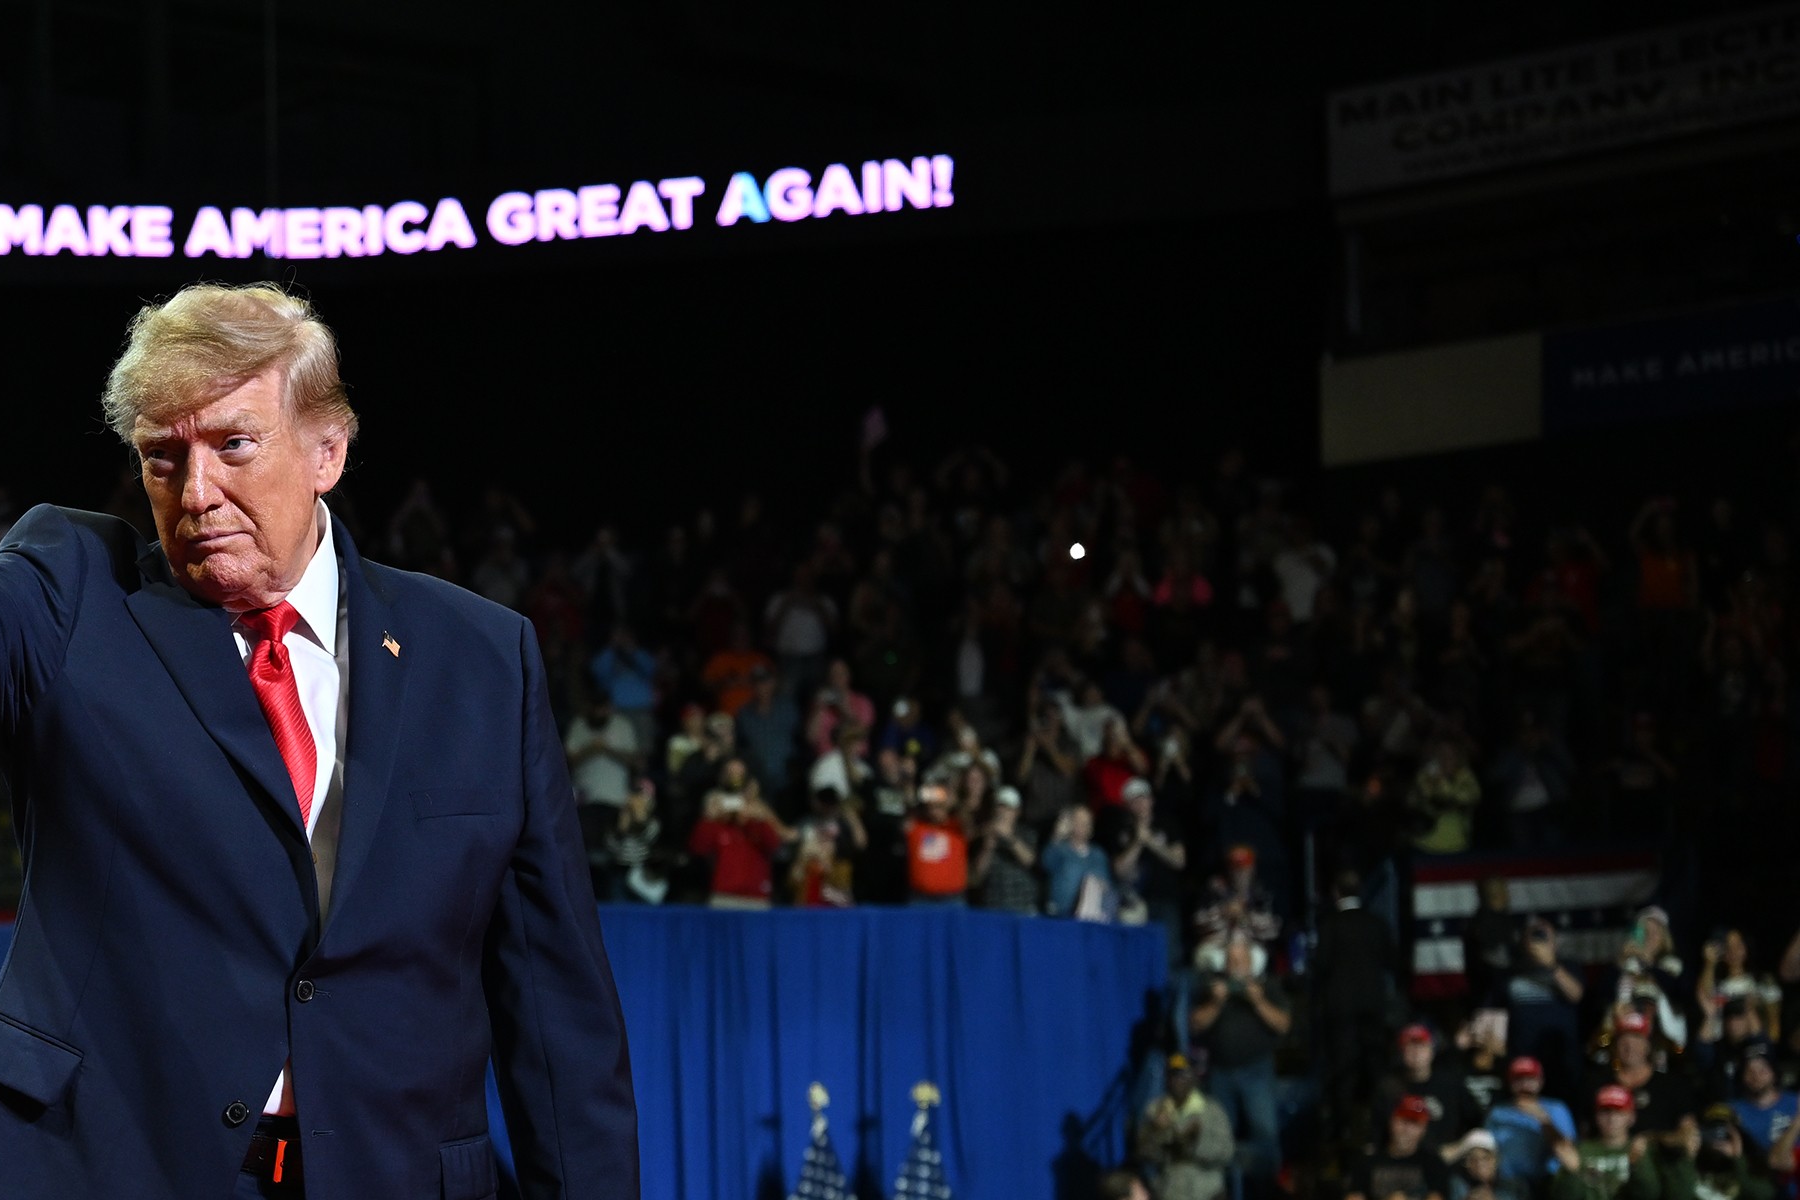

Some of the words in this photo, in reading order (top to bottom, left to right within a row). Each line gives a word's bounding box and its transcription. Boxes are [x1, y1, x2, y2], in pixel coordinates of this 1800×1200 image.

[1338, 78, 1473, 128] MAIN
[1490, 56, 1597, 100] LITE
[1392, 77, 1665, 153] COMPANY
[183, 196, 477, 260] AMERICA
[485, 175, 706, 246] GREAT
[715, 153, 955, 227] AGAIN!
[1571, 354, 1664, 391] MAKE
